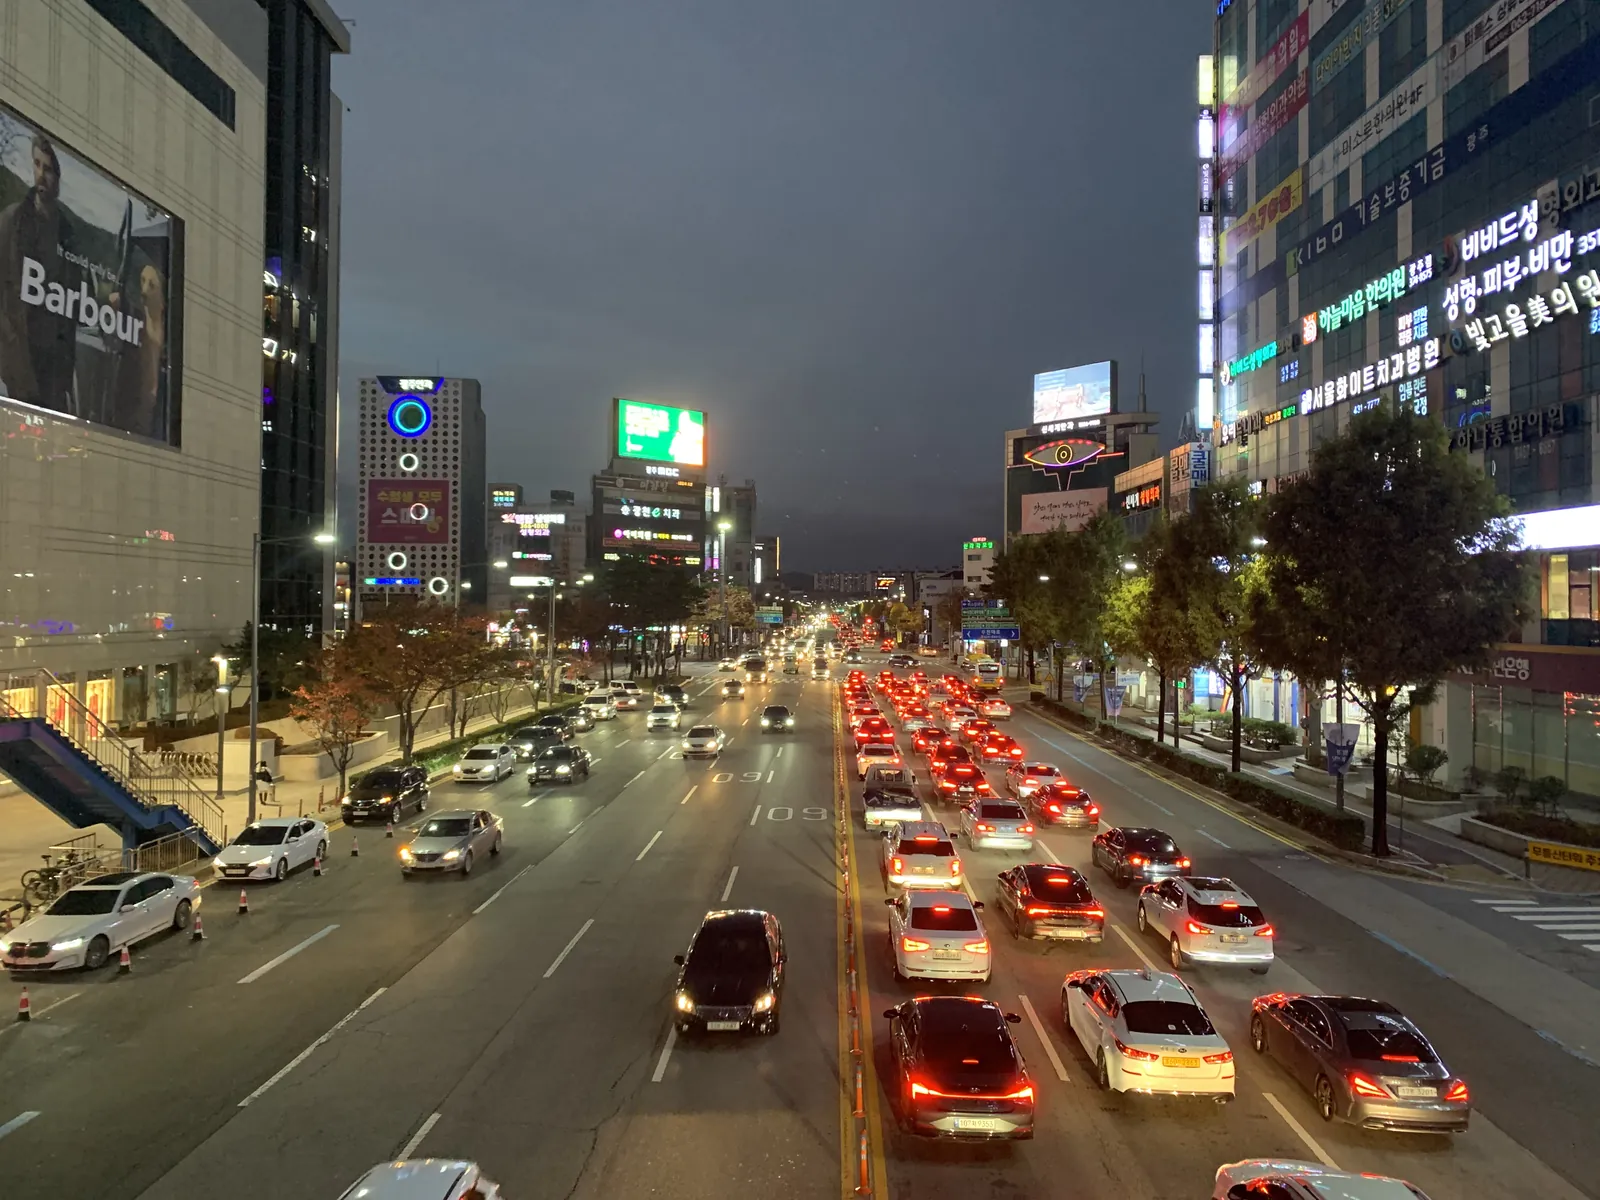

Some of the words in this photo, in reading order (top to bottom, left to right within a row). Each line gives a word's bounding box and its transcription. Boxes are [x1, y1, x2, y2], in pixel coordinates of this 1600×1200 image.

[1355, 147, 1446, 226] 기술보증기금
[20, 255, 144, 346] Barbour
[1313, 337, 1439, 410] 서울화이트치과병원
[418, 490, 442, 503] 모두
